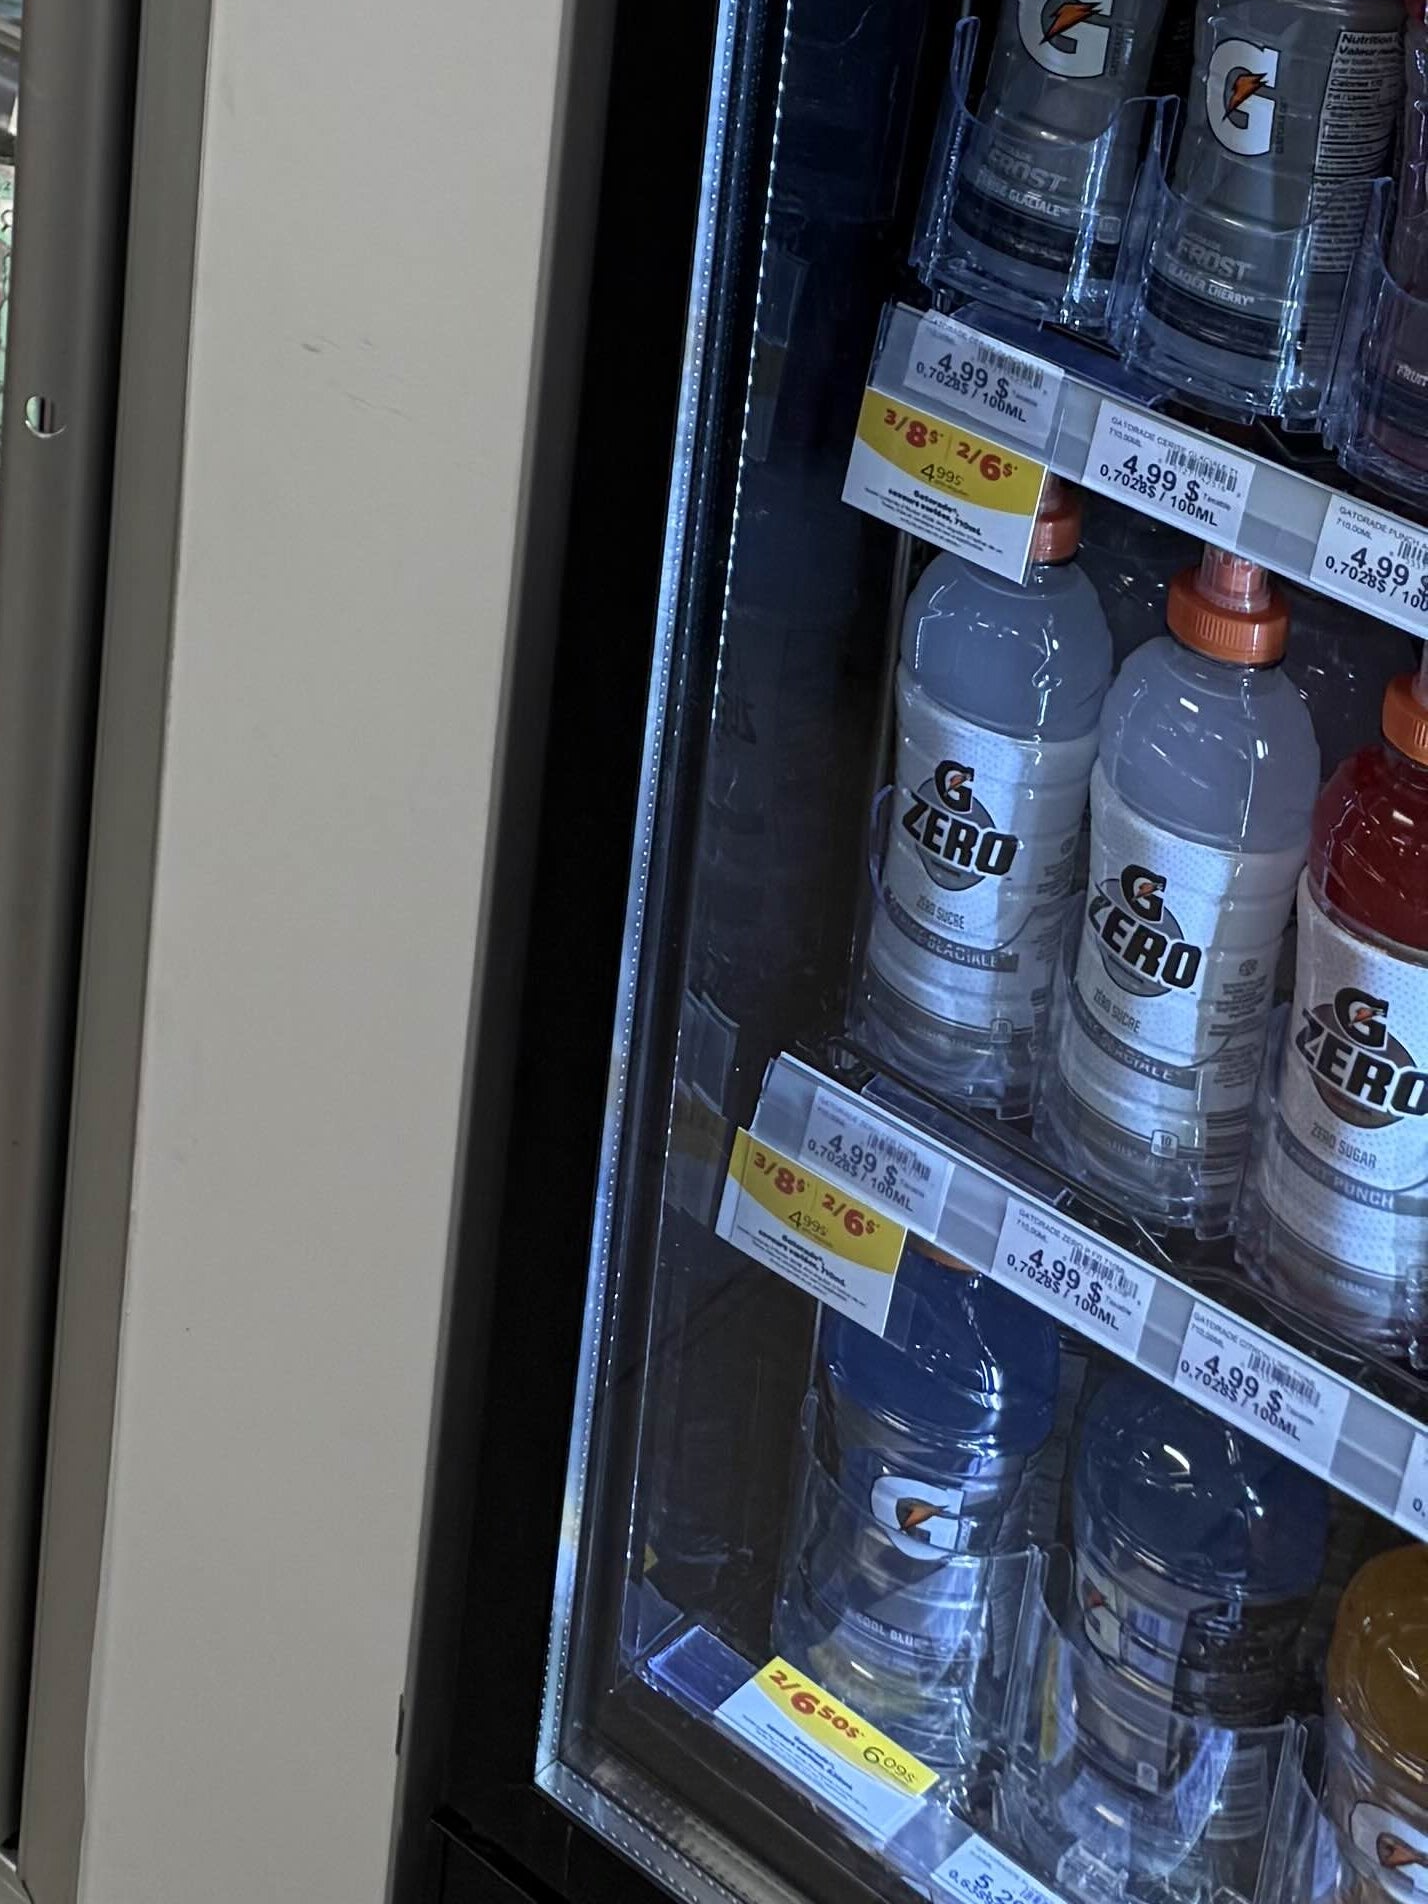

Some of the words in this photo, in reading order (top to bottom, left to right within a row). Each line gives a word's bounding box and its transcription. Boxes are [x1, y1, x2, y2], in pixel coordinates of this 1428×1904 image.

[981, 391, 1027, 423] 100ML
[1111, 416, 1156, 443] GATORADE
[1170, 495, 1219, 527] 100ML
[1338, 506, 1389, 535] GATORADE
[902, 790, 1019, 876] ZERO
[937, 906, 965, 930] SUCRE
[1089, 894, 1202, 990] ZERO
[1111, 1004, 1142, 1034] SUCRE
[1310, 1121, 1338, 1146] ZERO
[1338, 1141, 1378, 1170] SUGAR
[870, 1177, 913, 1212] 100ML
[1072, 1293, 1120, 1331] 100ML
[1252, 1401, 1301, 1442] 100ML
